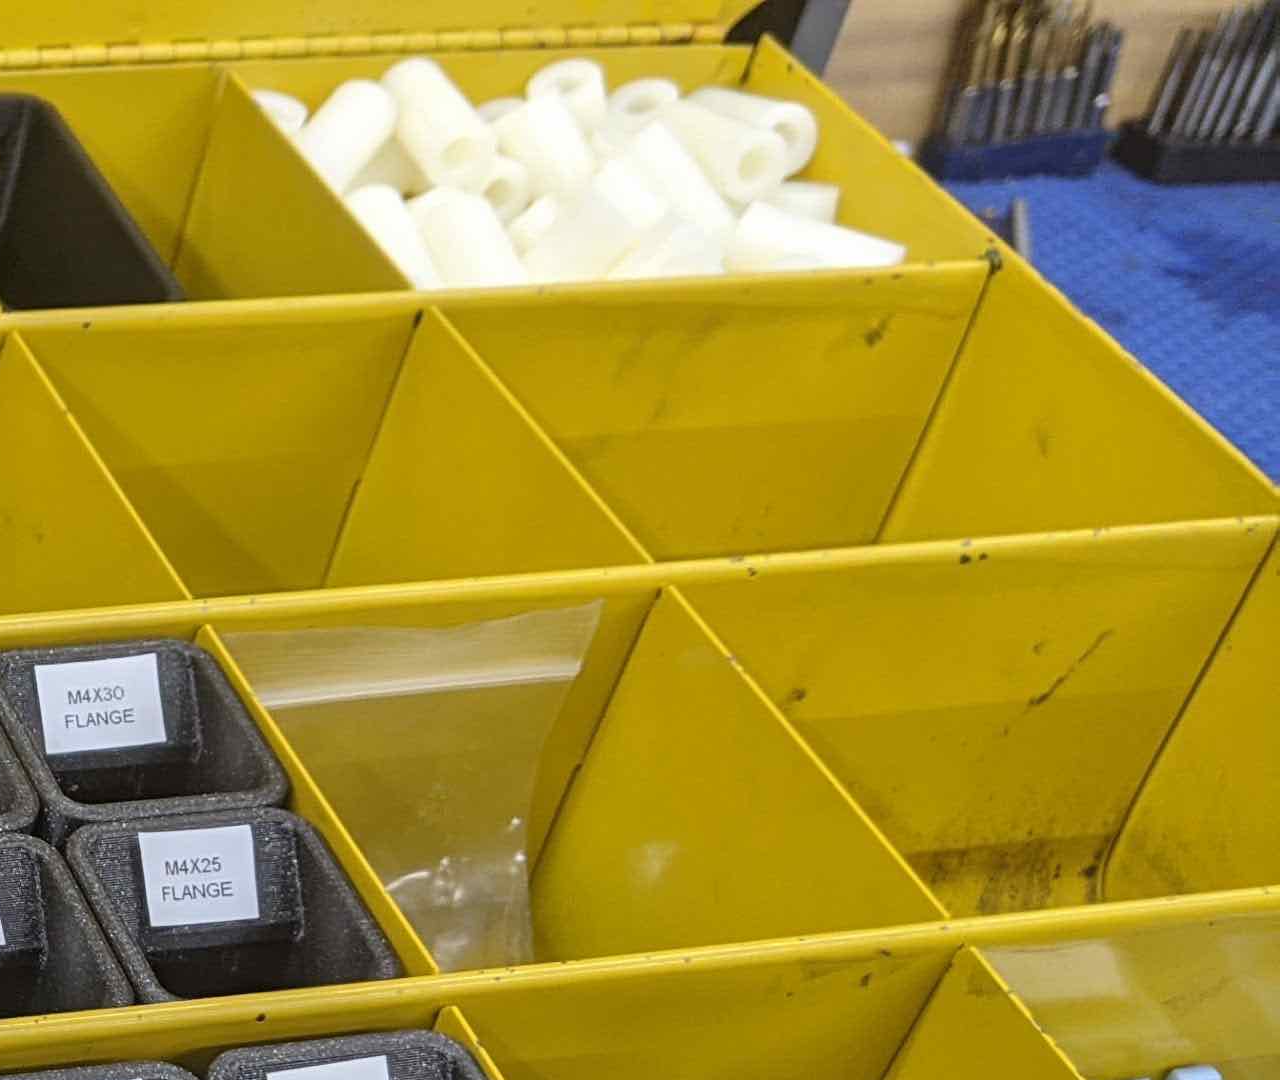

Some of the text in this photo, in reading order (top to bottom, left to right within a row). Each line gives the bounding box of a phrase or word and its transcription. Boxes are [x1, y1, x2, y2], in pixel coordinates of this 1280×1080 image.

[67, 685, 125, 705] M4X30
[64, 707, 136, 729] FLANGE
[164, 856, 222, 876] M4X25
[161, 881, 235, 902] FLANGE
